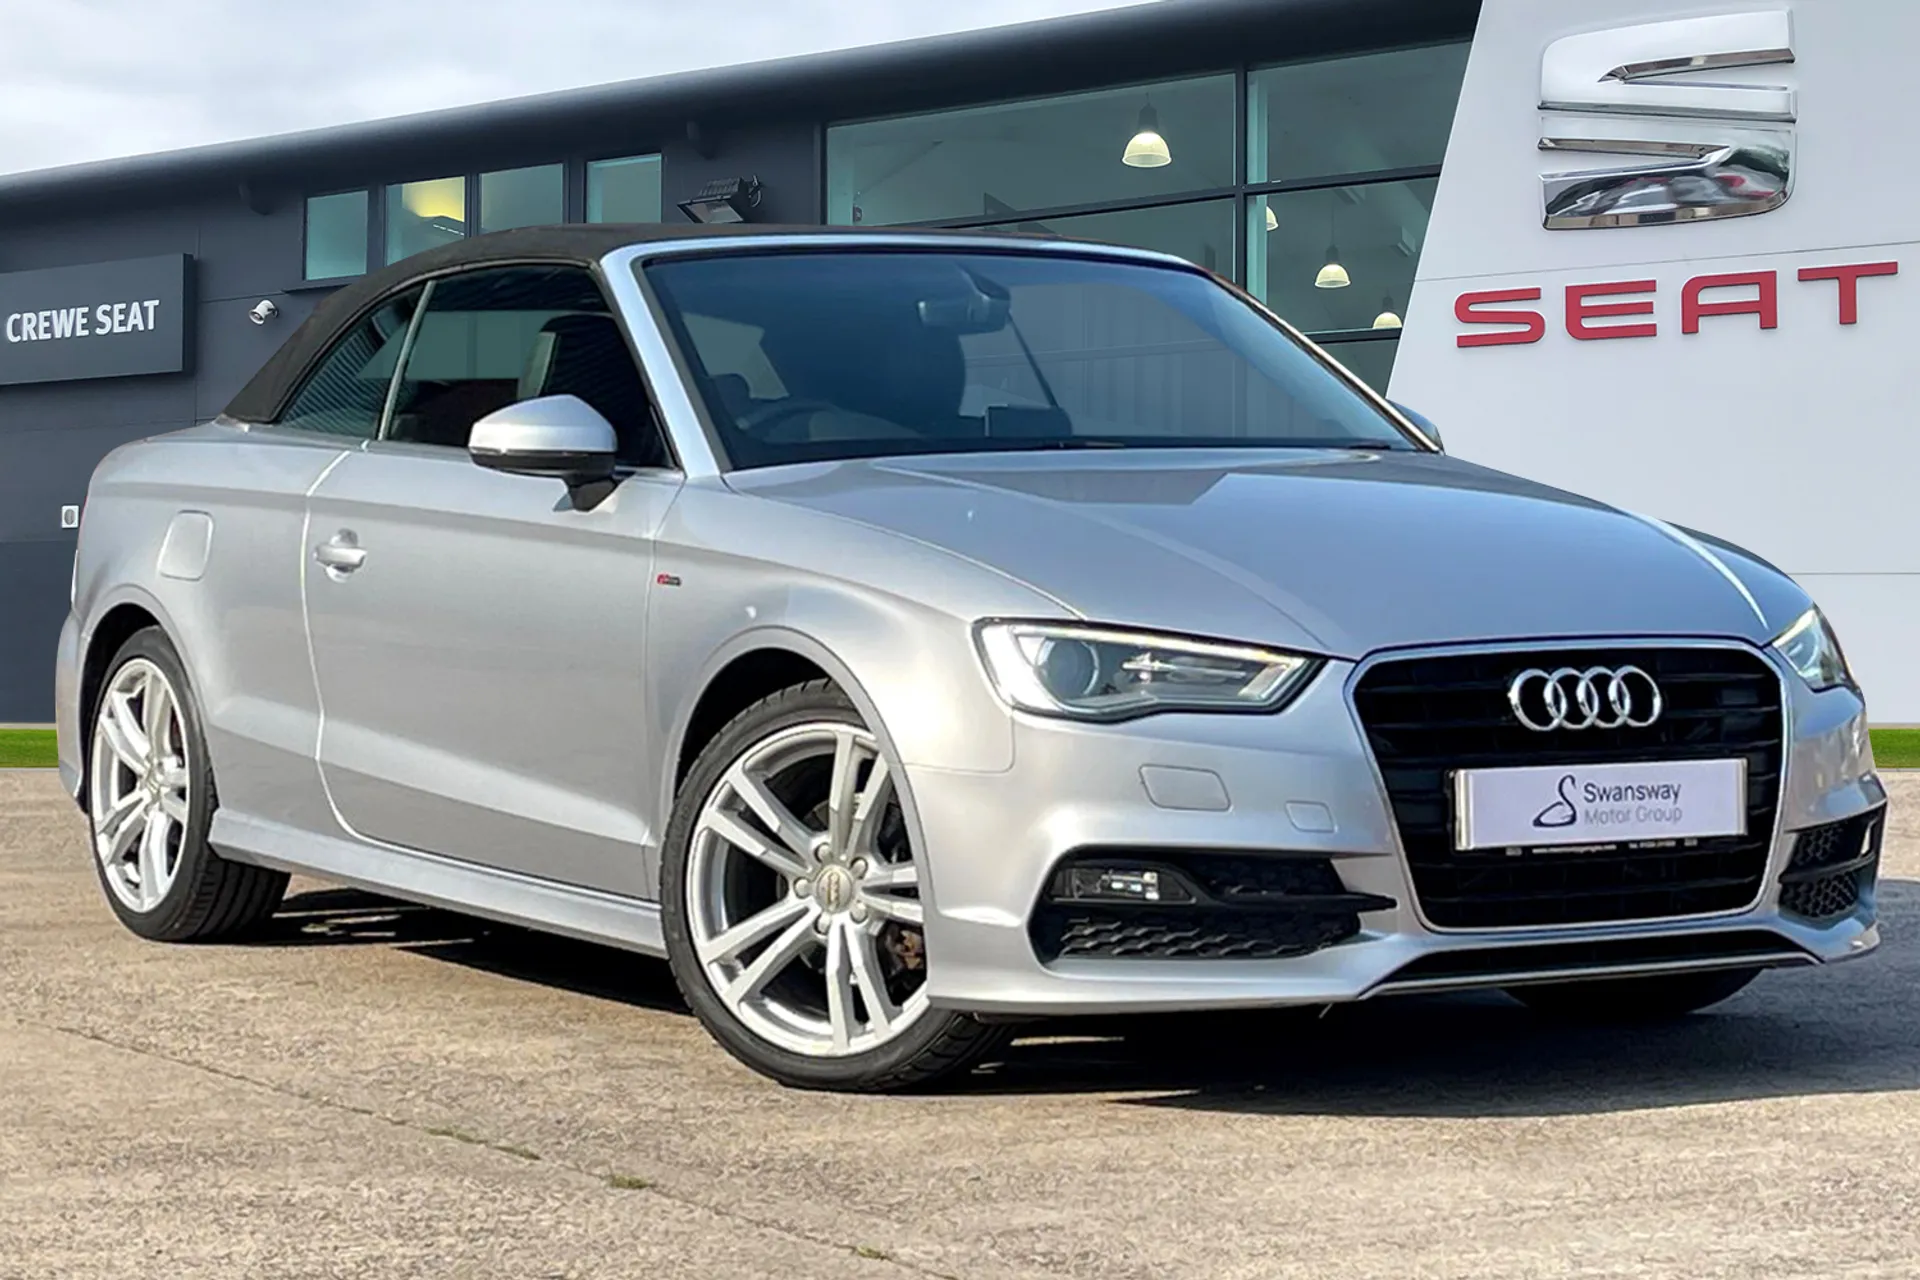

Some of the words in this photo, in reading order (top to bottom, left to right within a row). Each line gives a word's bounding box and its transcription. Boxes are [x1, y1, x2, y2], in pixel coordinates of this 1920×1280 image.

[6, 307, 90, 343] CREWE
[95, 299, 160, 336] SEAT
[1454, 261, 1899, 348] SEAT
[1584, 782, 1682, 805] Swansway
[1584, 808, 1631, 826] Motor
[1635, 805, 1683, 825] Group
